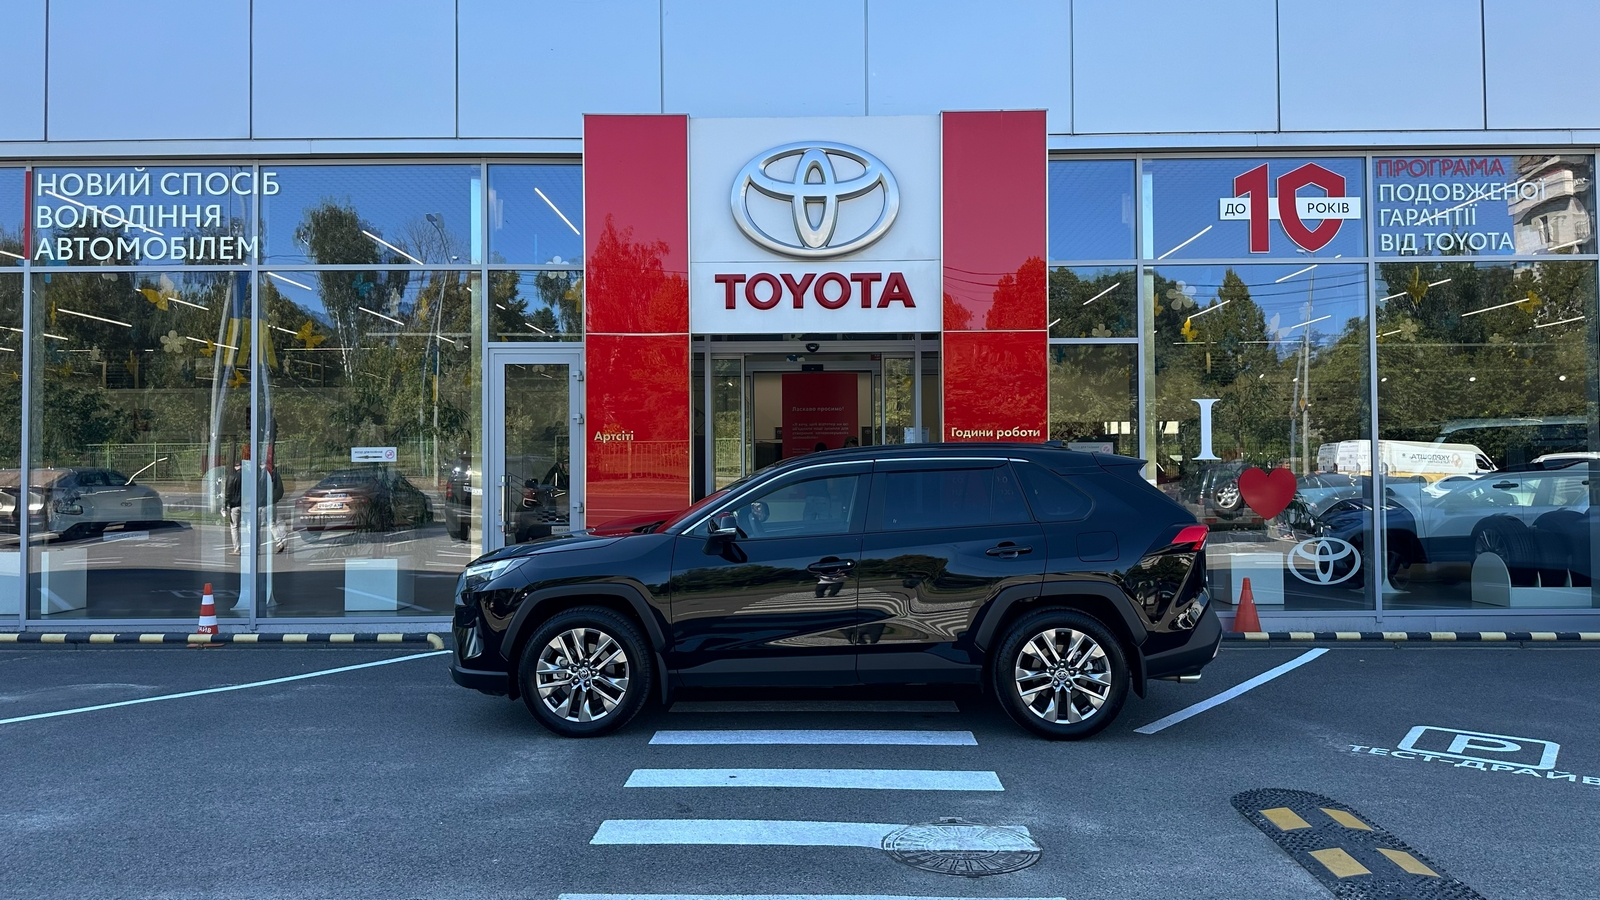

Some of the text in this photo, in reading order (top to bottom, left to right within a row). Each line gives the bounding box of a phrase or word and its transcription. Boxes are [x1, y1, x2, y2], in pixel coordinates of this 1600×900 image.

[1376, 158, 1505, 176] ПРОГРАМА
[37, 166, 280, 196] НОВИЙ СПОСІБ
[1379, 178, 1547, 205] ПОДОВЖЕНОЇ
[36, 204, 222, 233] ВОЛОДІННЯ
[1224, 161, 1350, 254] ДО 10 РОКІВ
[1380, 203, 1478, 226] ГАРАНТІЇ
[34, 236, 259, 261] АВТОМОБІЛЕМ
[1381, 232, 1515, 255] ВІД TOYOTA
[714, 271, 917, 311] TOYOTA
[594, 430, 634, 443] Артсіті
[951, 425, 1041, 440] Години роботи
[1190, 398, 1222, 461] I
[1348, 744, 1600, 785] ТЕСТ-ДРАЙВ
